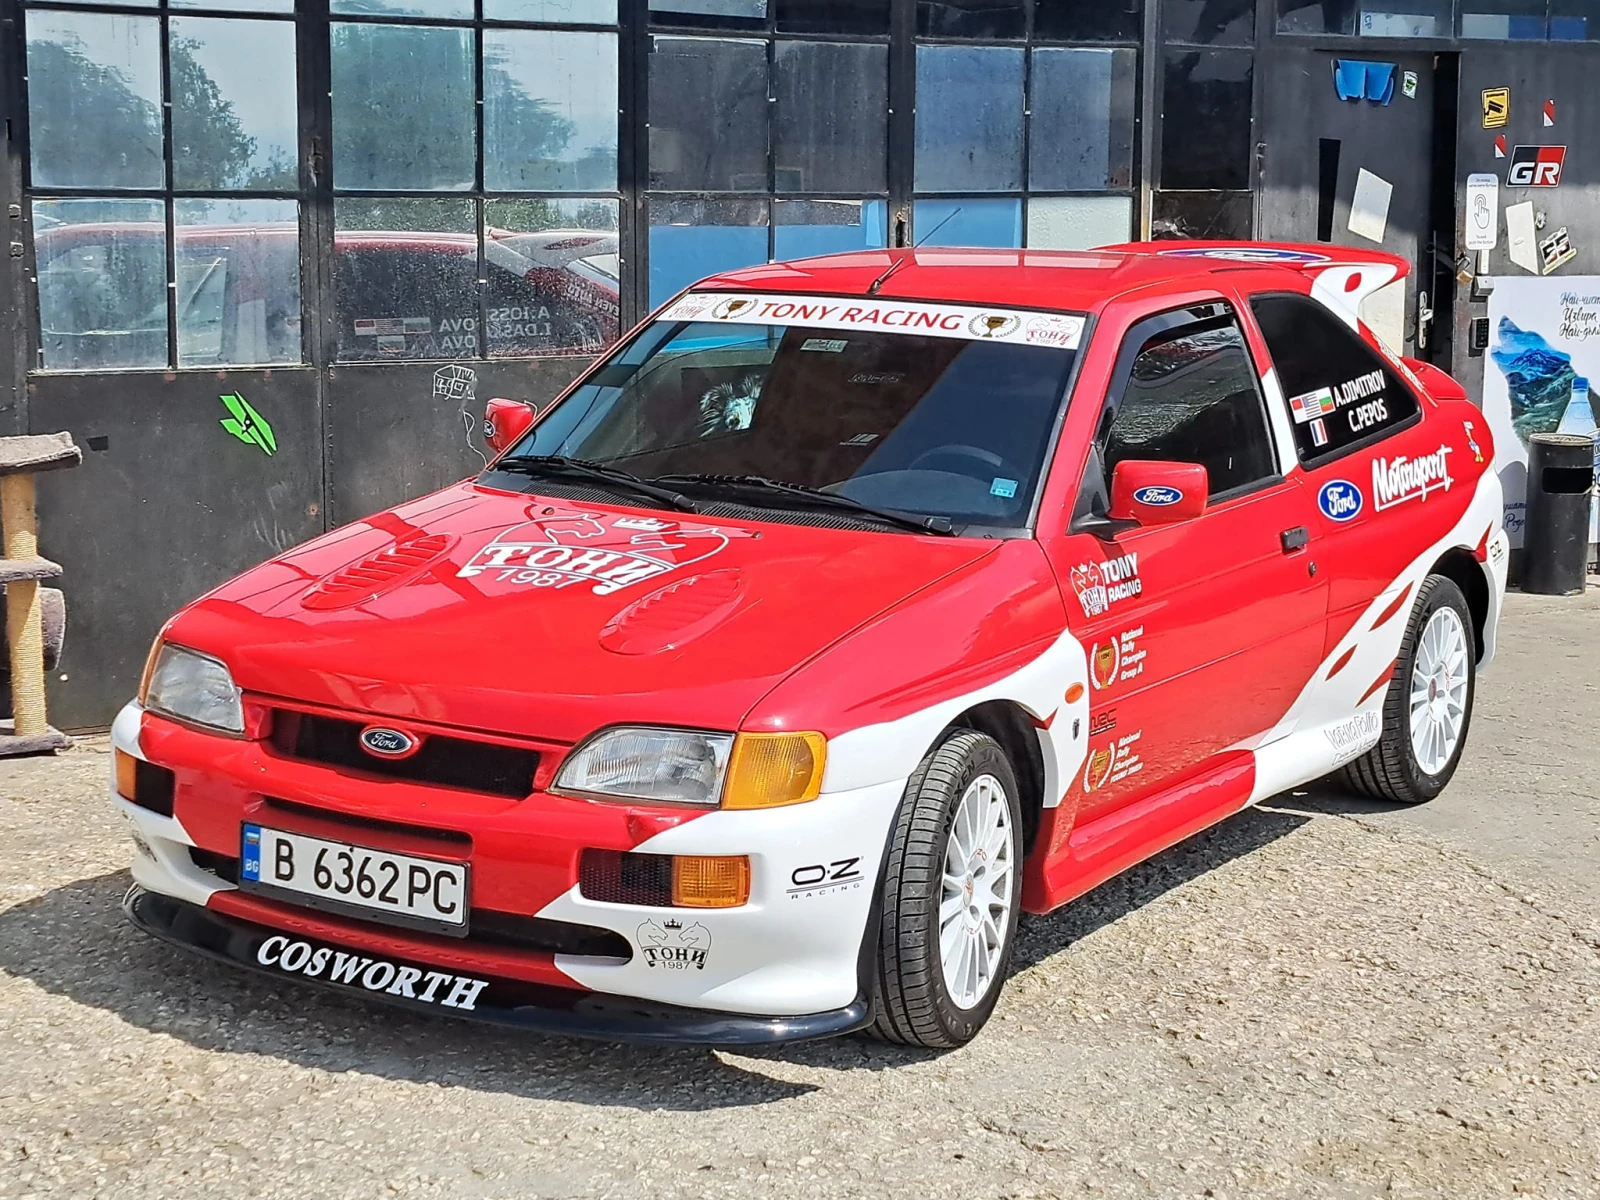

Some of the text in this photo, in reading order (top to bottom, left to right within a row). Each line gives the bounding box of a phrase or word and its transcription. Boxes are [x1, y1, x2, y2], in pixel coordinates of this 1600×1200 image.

[1510, 162, 1560, 184] GR
[758, 302, 964, 330] TONY RACING
[1333, 369, 1386, 407] A.DIMITROV
[1347, 398, 1388, 432] C.PEPOS
[1326, 444, 1454, 516] Ford Motorsport
[1142, 488, 1174, 502] Ford
[484, 545, 666, 585] ТОНИ
[1100, 552, 1138, 584] TONY
[493, 568, 589, 589] 1987
[1107, 578, 1142, 603] RACING
[370, 732, 399, 749] Ford
[245, 859, 259, 873] BG
[274, 838, 294, 881] B
[791, 883, 860, 900] RACING
[643, 947, 706, 963] ТОНИ
[661, 961, 690, 970] 1987
[257, 936, 489, 1010] COSWORTH
